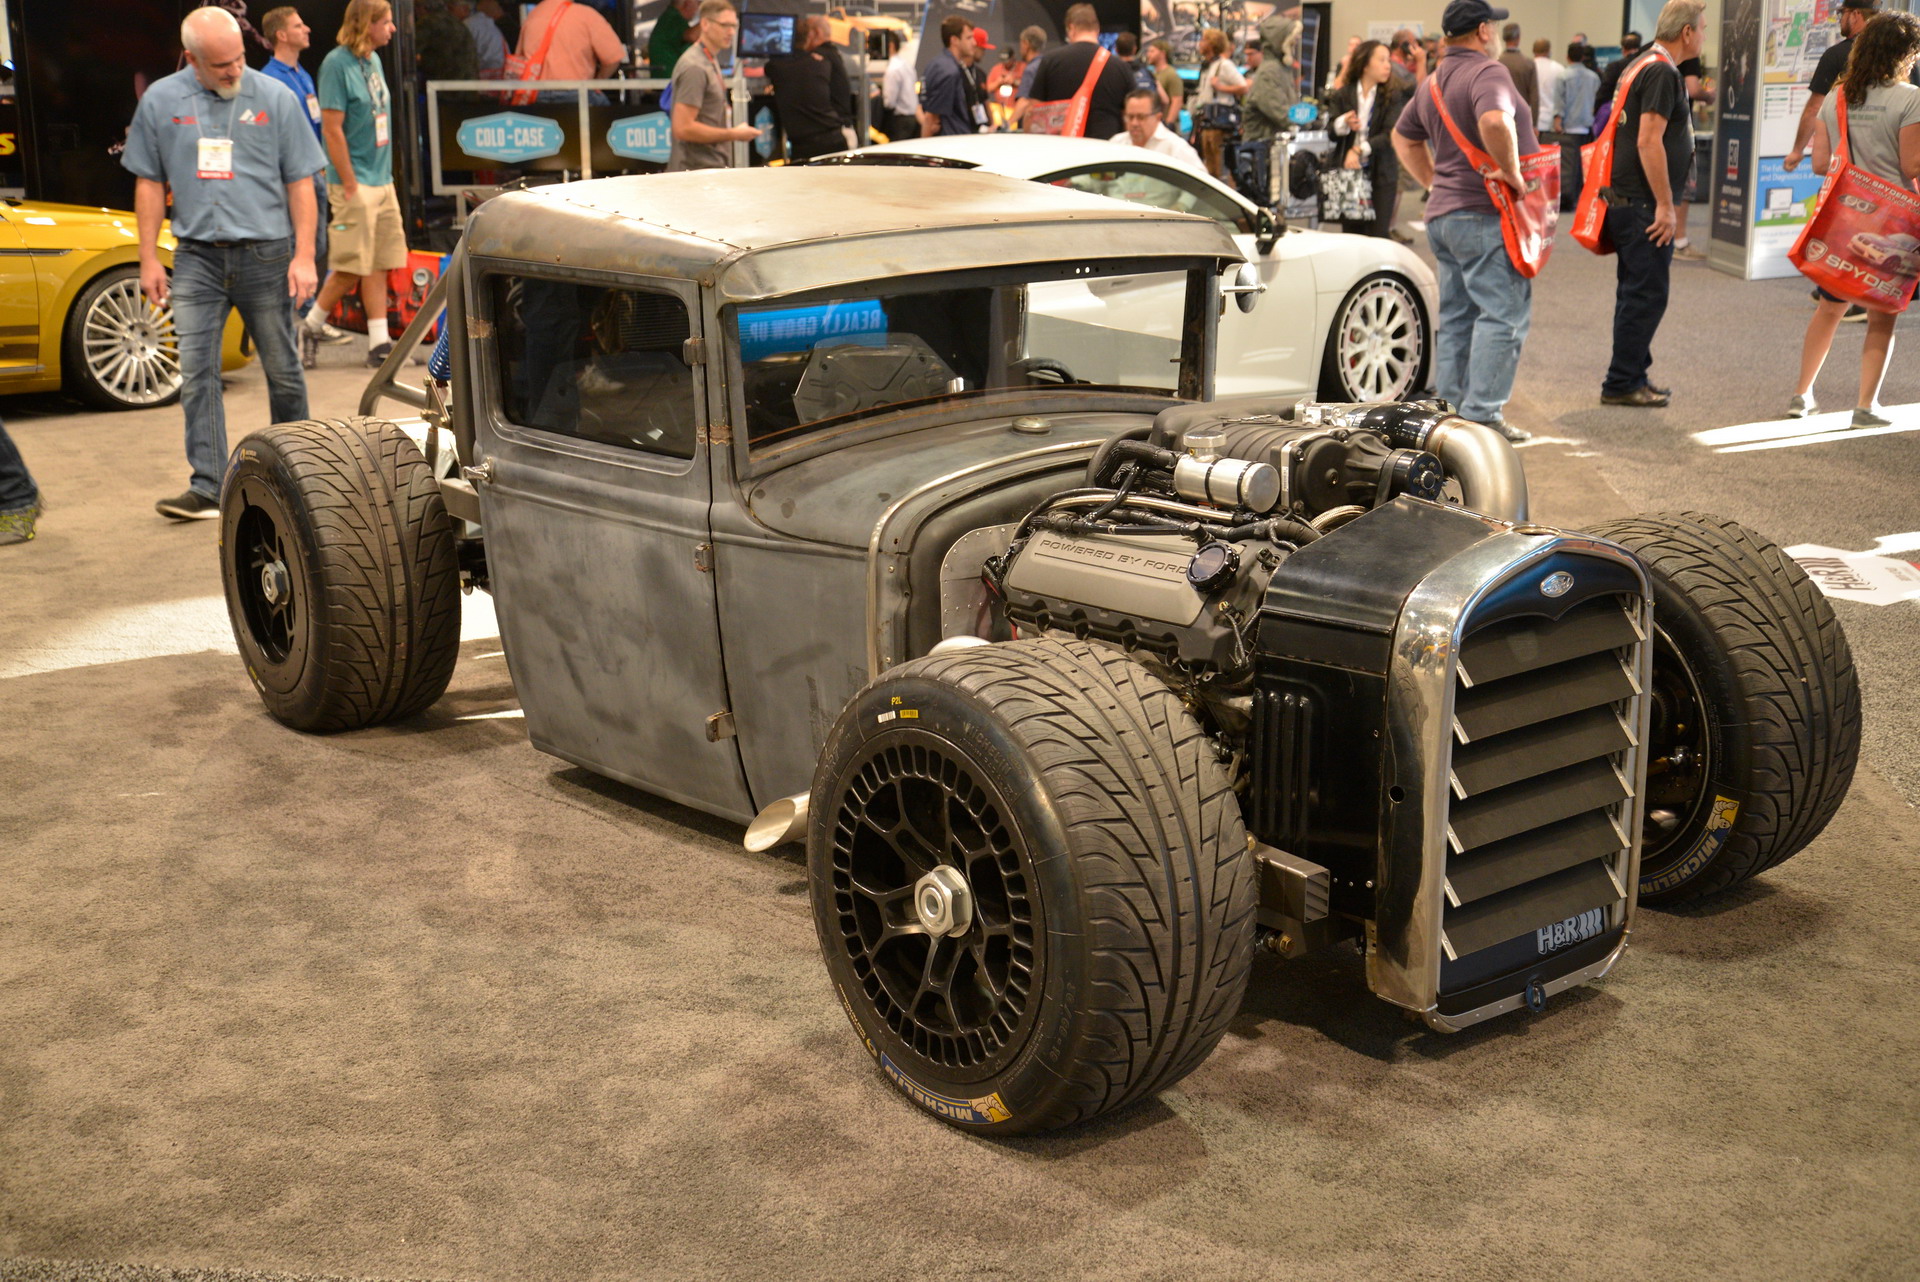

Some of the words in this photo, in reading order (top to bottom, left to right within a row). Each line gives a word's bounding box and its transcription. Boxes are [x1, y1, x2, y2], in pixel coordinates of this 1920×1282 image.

[475, 127, 545, 147] COLD-CASE
[626, 127, 671, 147] COLD-C
[1825, 253, 1904, 300] SPYDER
[1040, 539, 1115, 560] POWERED
[1117, 553, 1142, 565] BY
[1143, 559, 1188, 575] FORD
[1640, 834, 1719, 894] MICHELIN
[885, 1064, 974, 1121] MICHELIN
